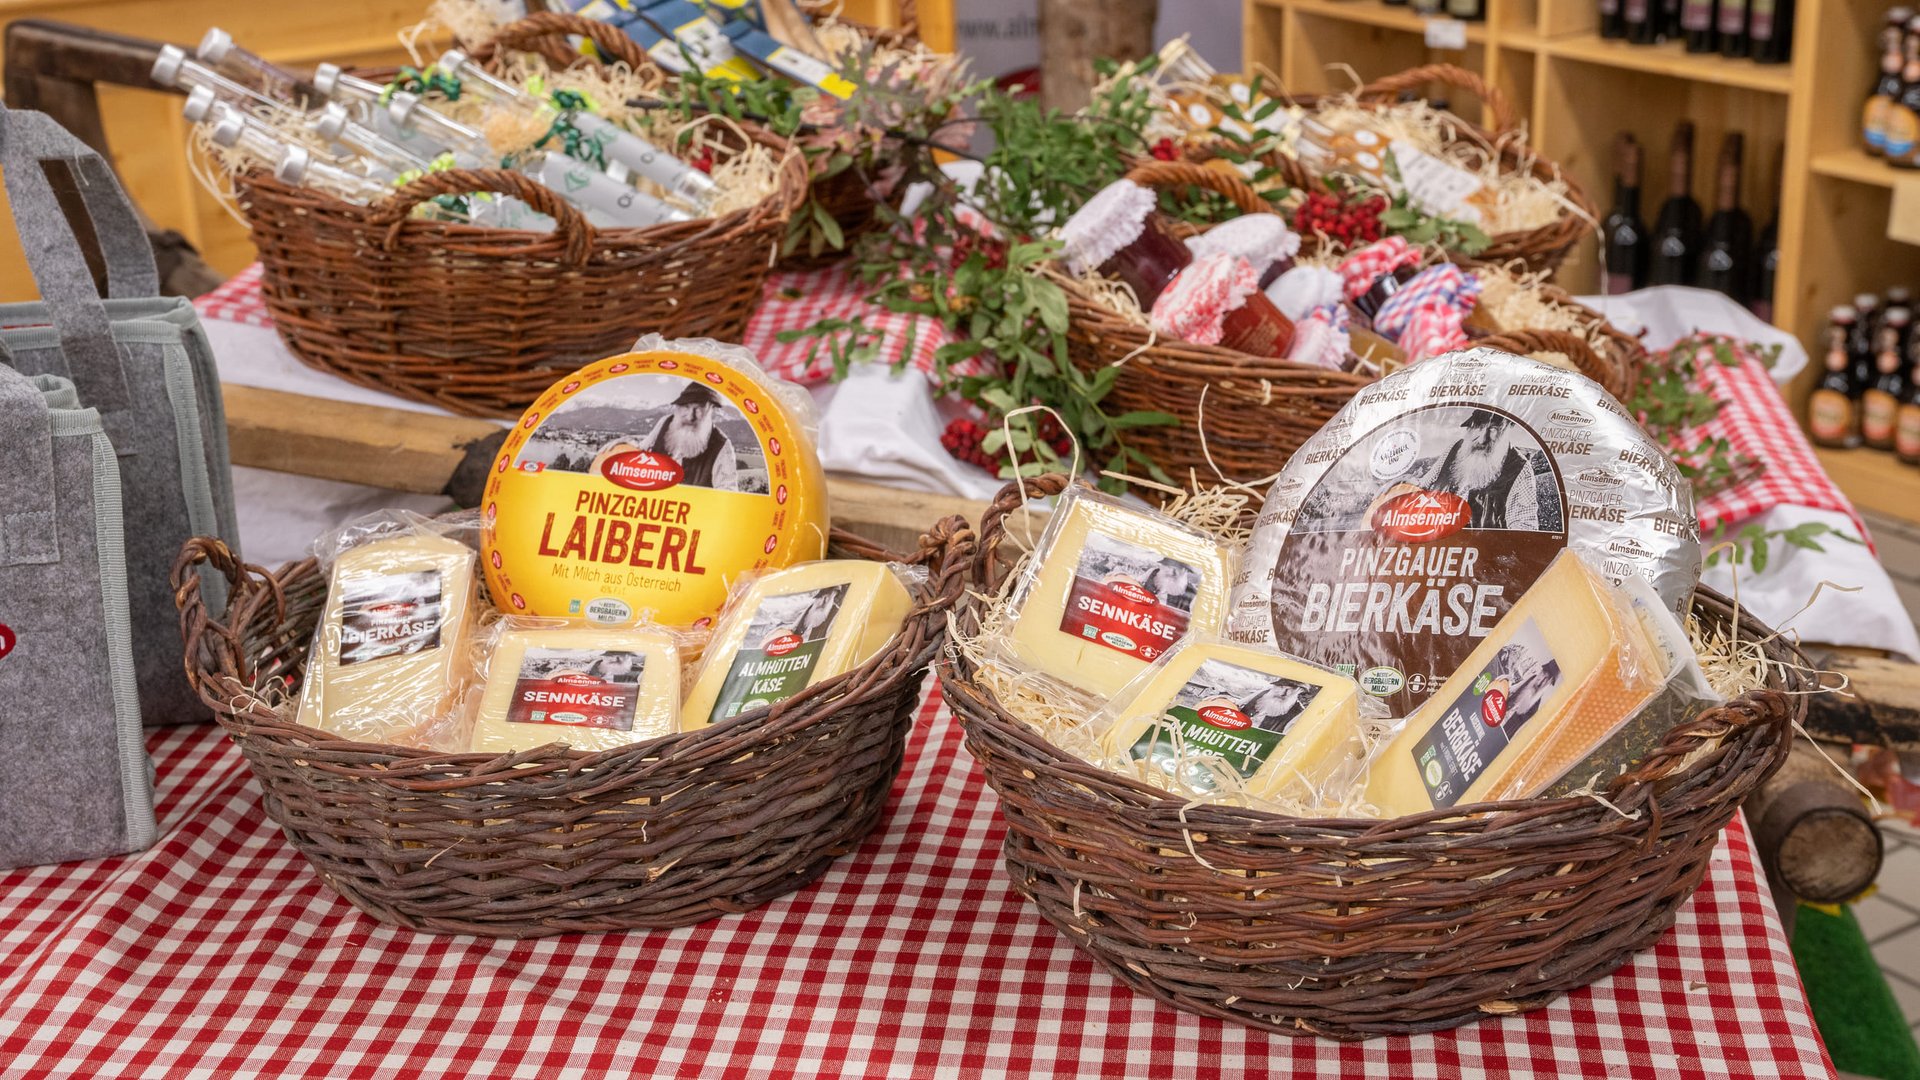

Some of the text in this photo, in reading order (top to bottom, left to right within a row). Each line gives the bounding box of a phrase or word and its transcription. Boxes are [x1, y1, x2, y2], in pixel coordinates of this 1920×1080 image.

[1429, 381, 1487, 398] BIERKÄSE
[1508, 383, 1572, 399] BIERKÄSE
[1550, 411, 1593, 425] Almsenner
[1540, 427, 1592, 441] PINZGAUER
[1544, 437, 1594, 456] ERKÄSE
[610, 461, 677, 483] Almsenner
[1579, 473, 1622, 485] Almsenner
[1619, 449, 1675, 494] BIERKÄSE
[1569, 489, 1623, 506] PINZGAUER
[575, 490, 691, 525] PINZGAUER
[1568, 504, 1627, 524] IERKÄSE
[1382, 510, 1461, 527] Almsenner
[538, 512, 706, 575] LAIBERL
[1609, 542, 1654, 559] Almsenner
[1339, 546, 1479, 577] PINZGAUER
[552, 563, 682, 592] Mit Milch aus Österreich
[1112, 584, 1156, 605] Almsenner
[589, 606, 628, 617] BERGBAUERN
[1300, 578, 1505, 638] BIERKÄSE
[1078, 596, 1177, 640] SENNKÄSE
[348, 617, 435, 644] BIERKÄSE
[766, 641, 800, 652] Almsenner
[738, 653, 812, 677] ALMHÜTTEN
[557, 677, 601, 685] Almsenner
[750, 676, 786, 695] KÄSE
[1363, 677, 1400, 686] BERGBAUERN
[1371, 685, 1389, 693] MILCH
[523, 691, 626, 708] SENNKÄSE
[1202, 709, 1247, 728] Almsenner
[1442, 707, 1483, 782] BERGKÄSE
